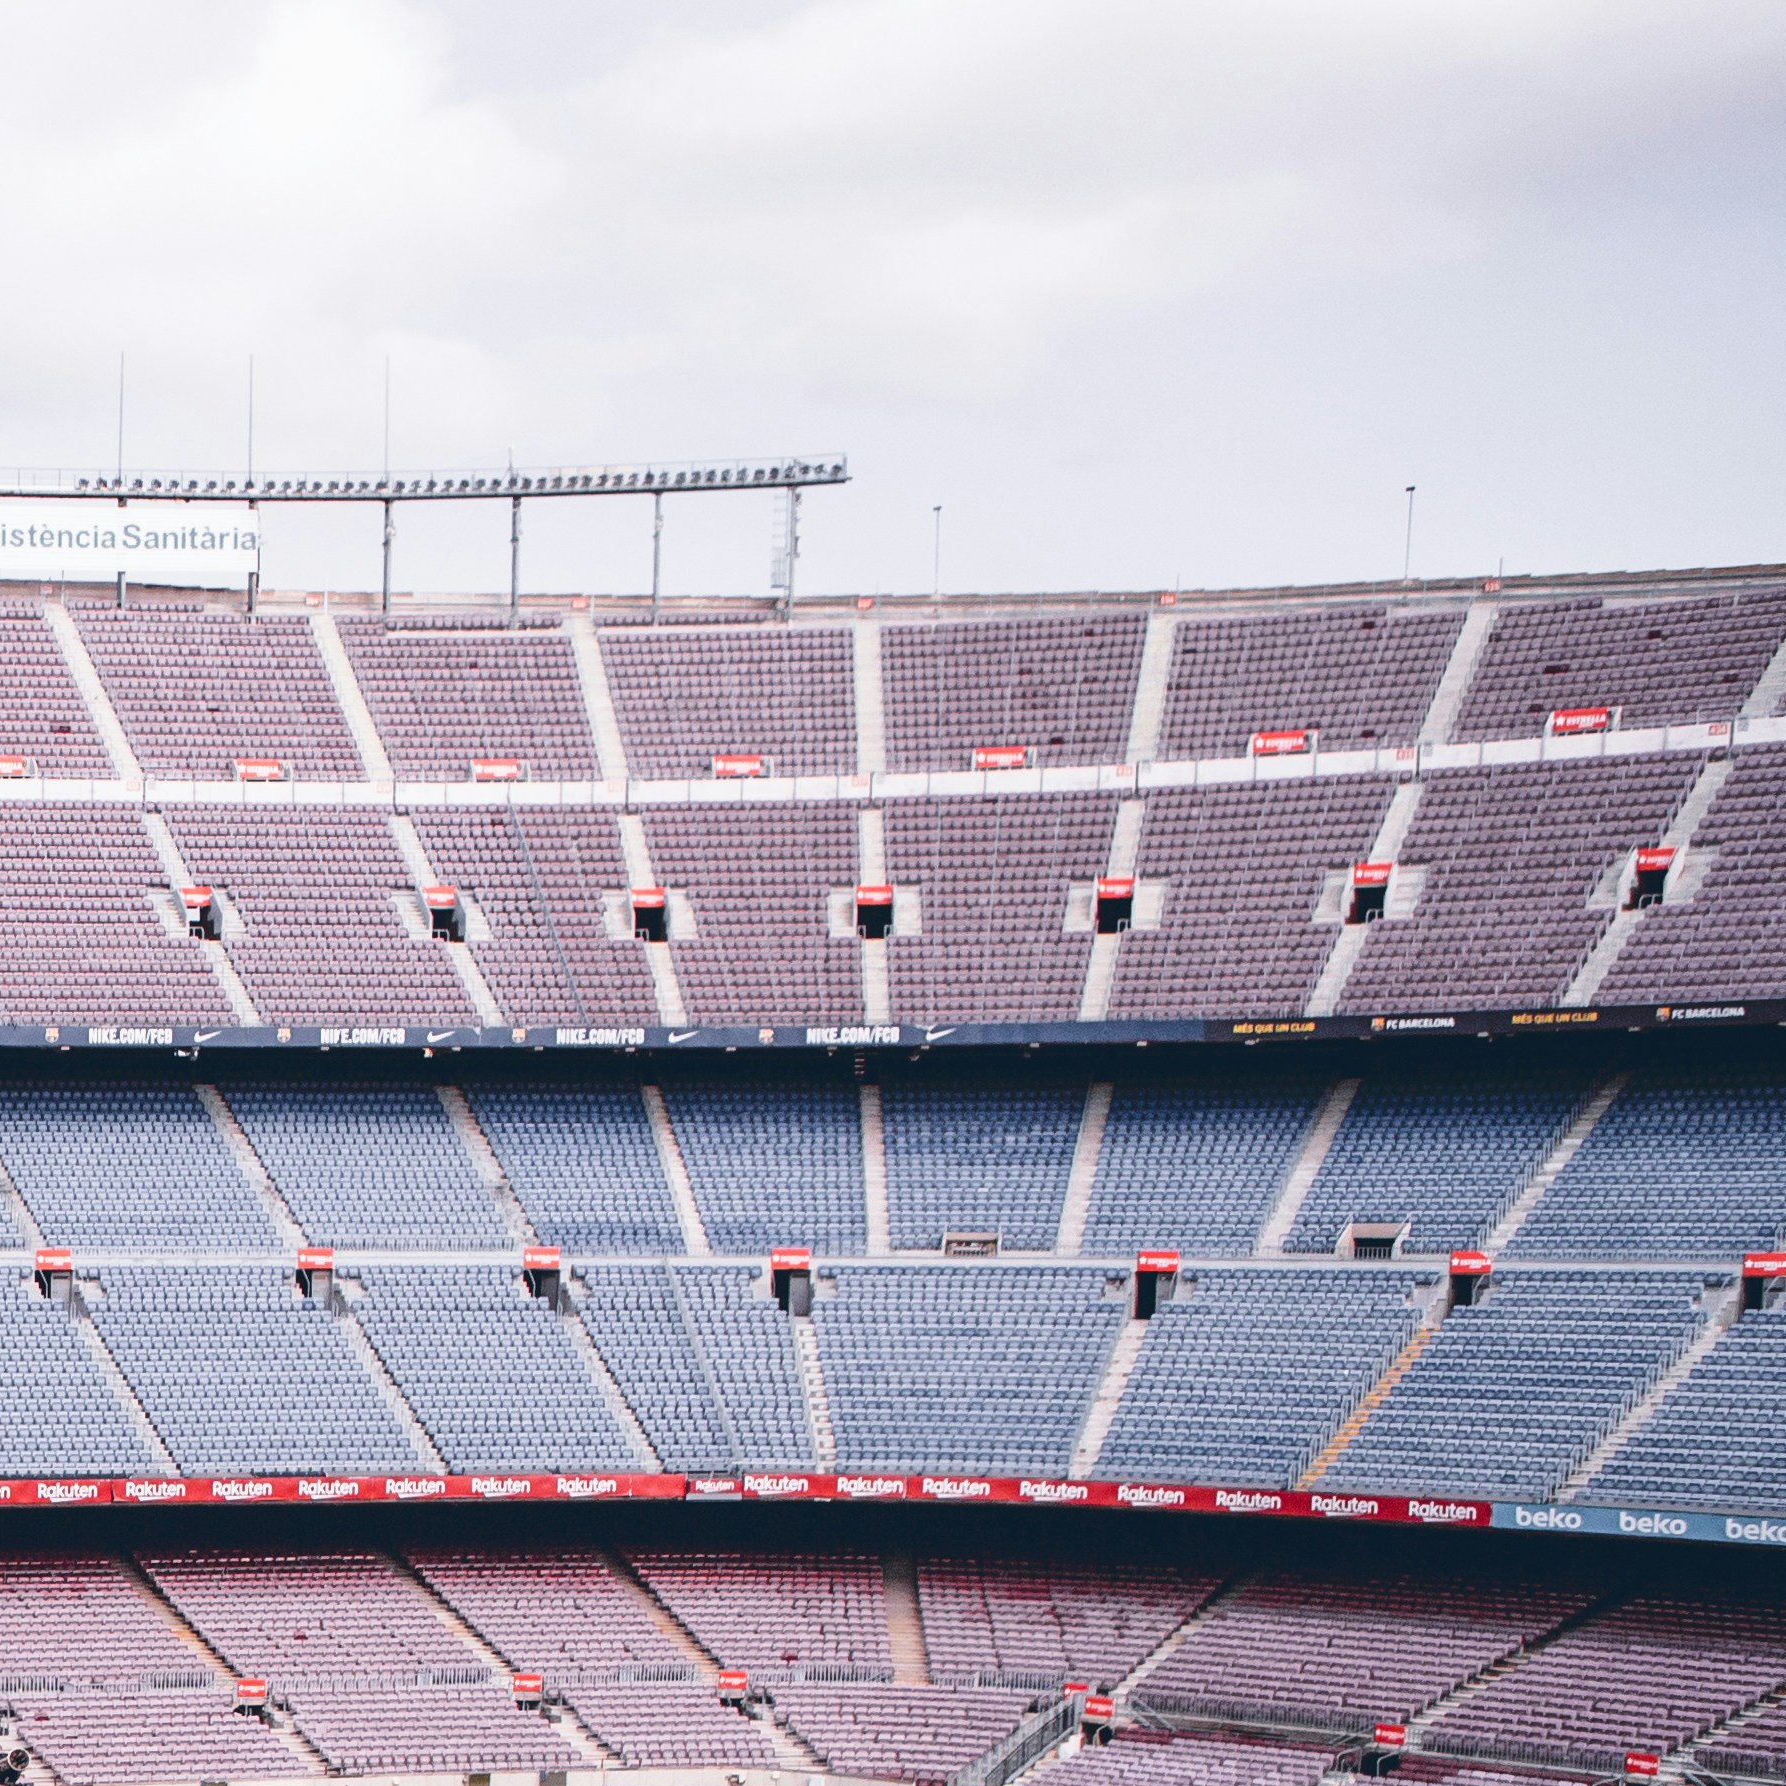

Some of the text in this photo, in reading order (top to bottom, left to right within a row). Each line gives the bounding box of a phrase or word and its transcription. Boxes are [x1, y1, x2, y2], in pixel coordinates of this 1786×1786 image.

[121, 523, 258, 552] Sanitària
[88, 1027, 173, 1044] NIKE.COM/FCB
[320, 1028, 405, 1045] NIKE.COM/FCB
[556, 1028, 645, 1045] NIKE.COM/FCB
[806, 1026, 900, 1045] NIKE.COM/FCB
[37, 1483, 98, 1500] Rakuten
[125, 1482, 186, 1499] Rakuten
[212, 1481, 273, 1498] Rakuten
[298, 1480, 359, 1497] Rakuten
[385, 1479, 446, 1496] Rakuten
[471, 1478, 531, 1495] Rakuten
[556, 1477, 617, 1494] Rakuten
[744, 1476, 809, 1493] Rakuten
[837, 1477, 904, 1495] Rakuten
[922, 1478, 990, 1497] Rakuten
[1019, 1481, 1088, 1501] Rakuten
[1117, 1485, 1185, 1505] Rakuten
[1215, 1490, 1281, 1511] Rakuten
[1310, 1494, 1379, 1516] Rakuten
[1408, 1501, 1477, 1522] Rakuten
[1515, 1507, 1582, 1530] beko
[1619, 1512, 1687, 1536] beko
